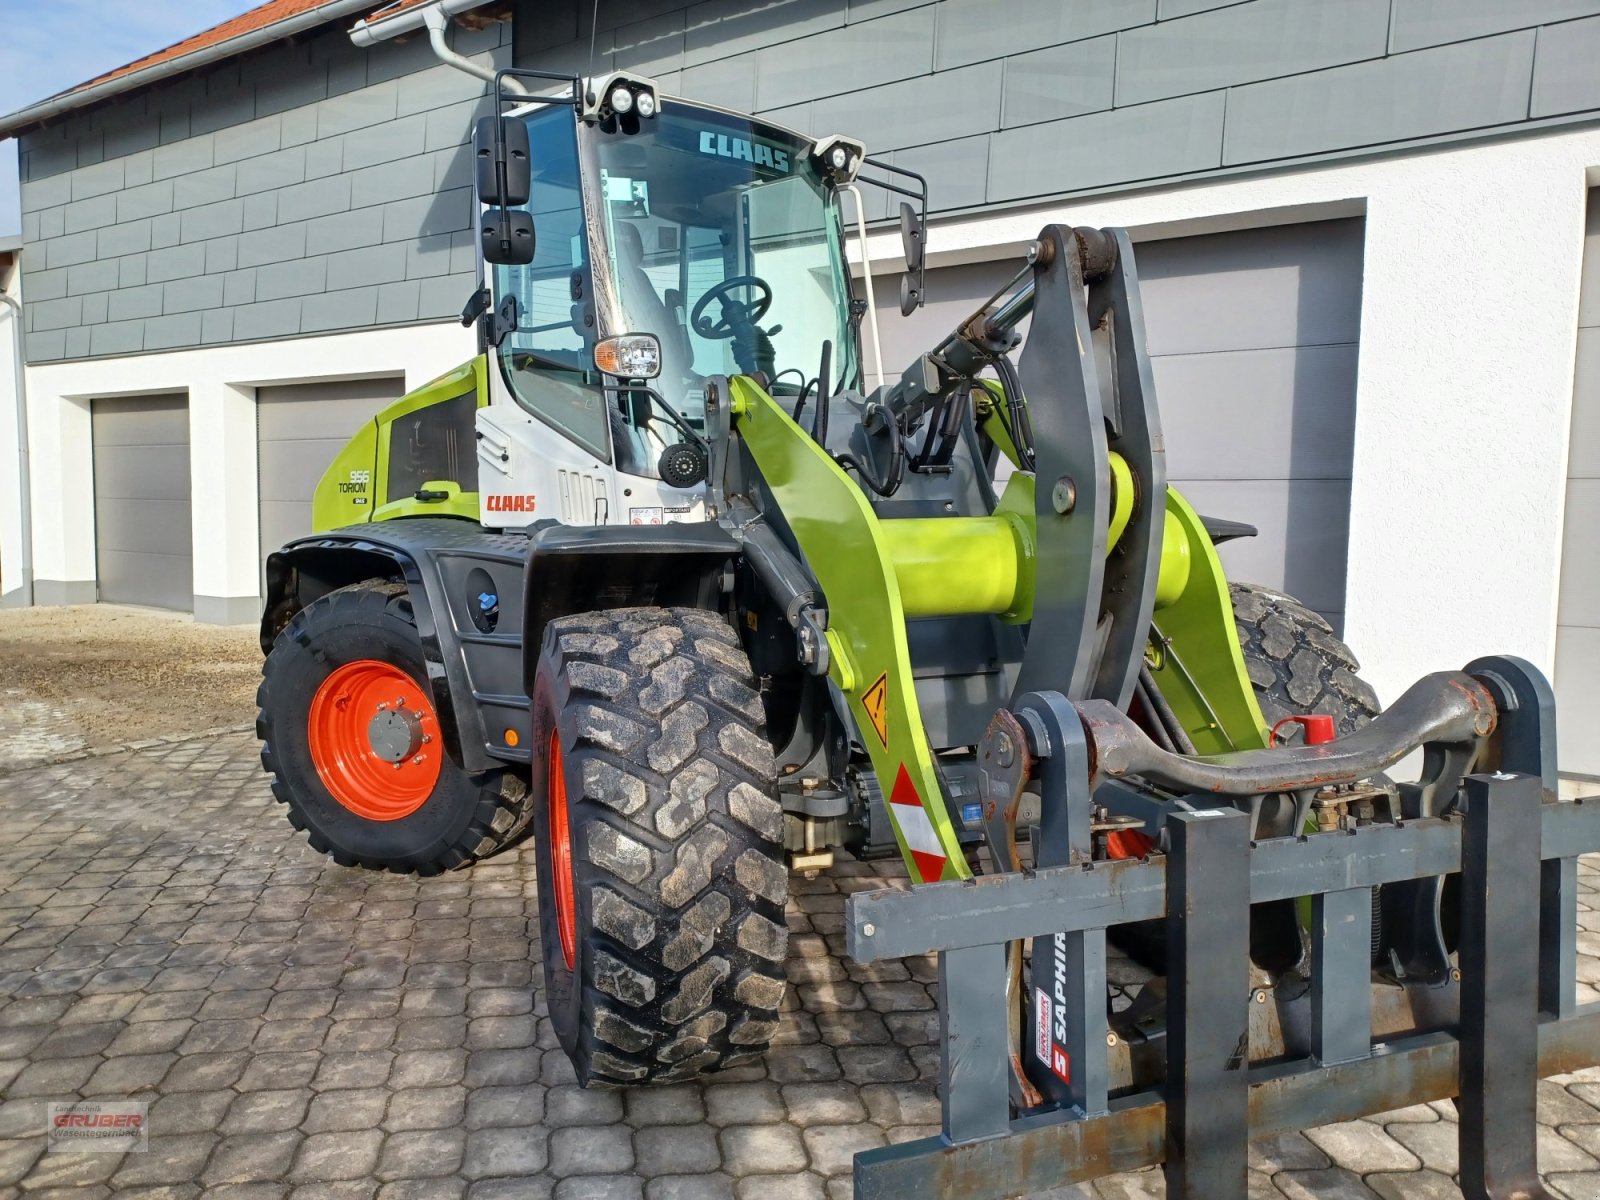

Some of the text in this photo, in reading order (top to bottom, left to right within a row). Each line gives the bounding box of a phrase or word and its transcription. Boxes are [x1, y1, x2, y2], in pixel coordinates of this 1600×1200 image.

[699, 130, 789, 173] CLAAS
[350, 470, 370, 483] 956
[338, 482, 366, 493] TORION
[486, 495, 536, 512] CLAAS
[1054, 932, 1067, 1045] SAPHIR
